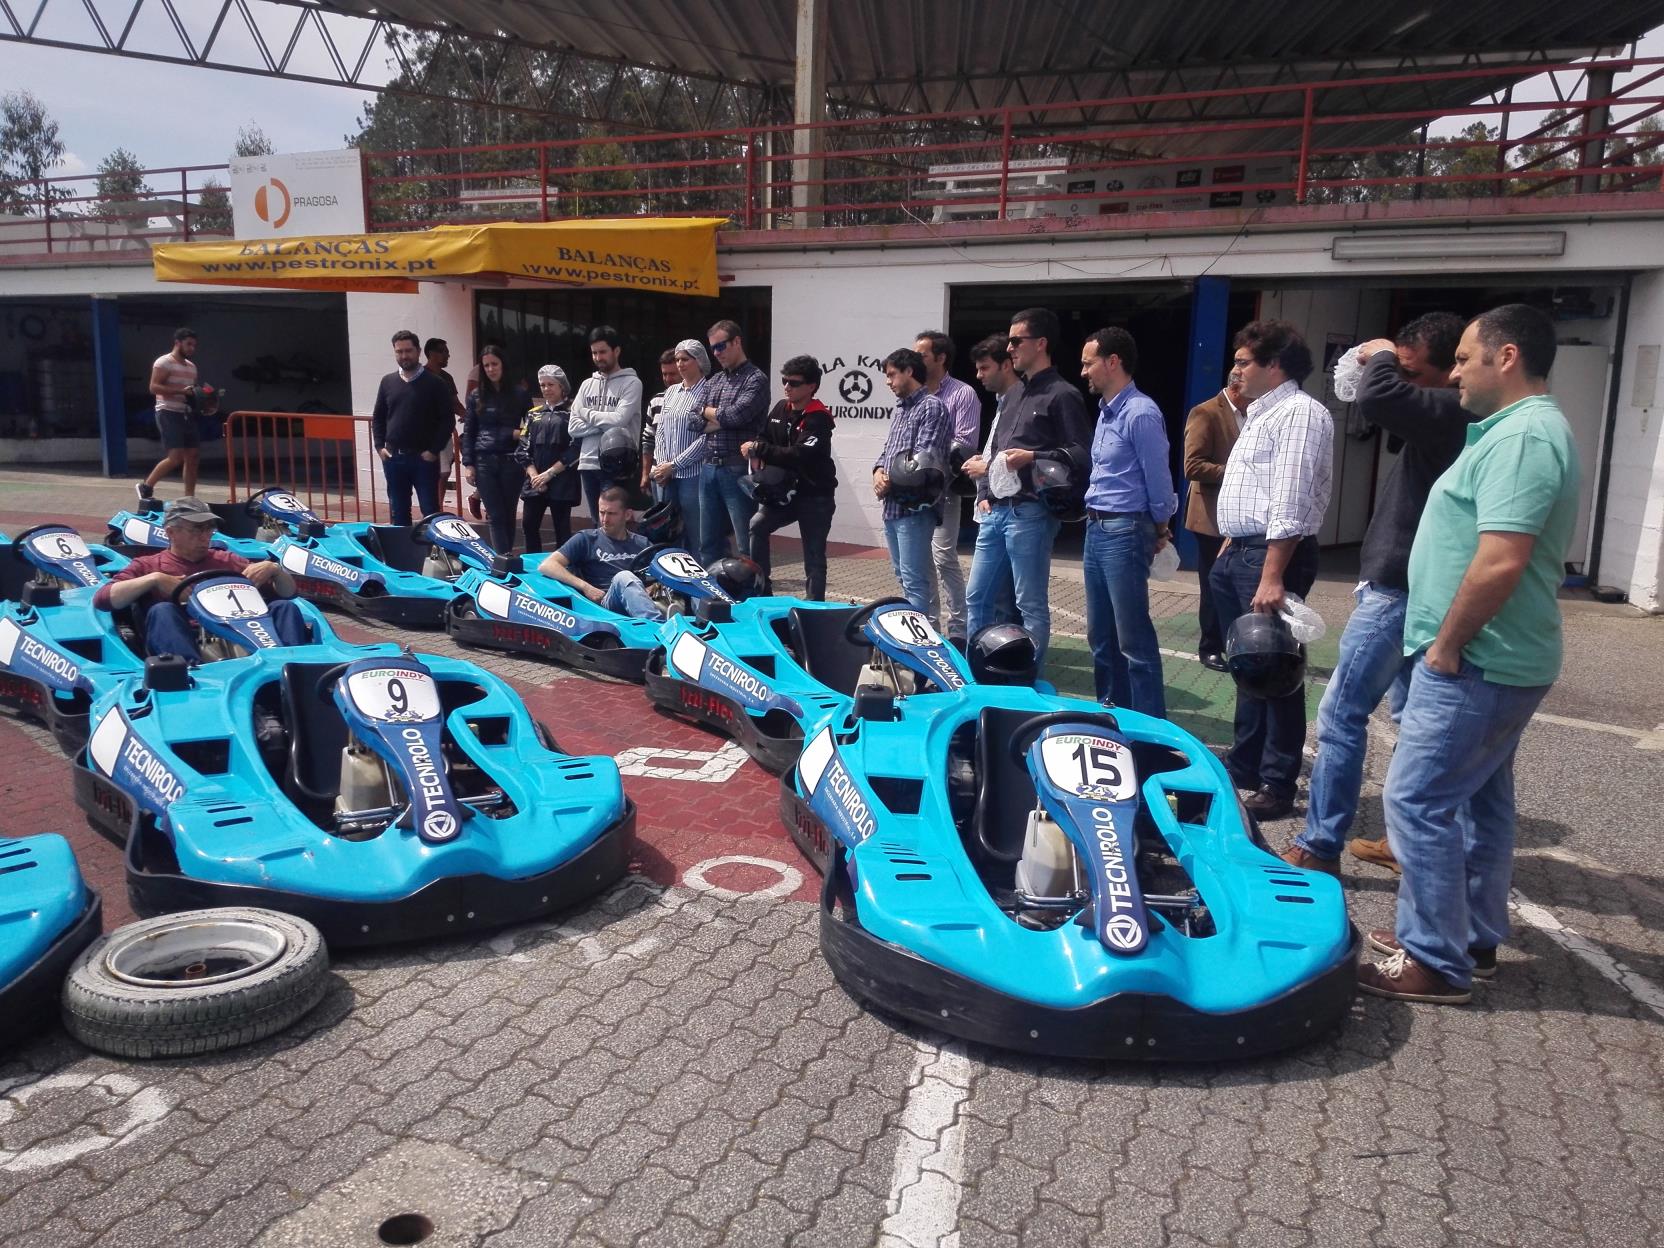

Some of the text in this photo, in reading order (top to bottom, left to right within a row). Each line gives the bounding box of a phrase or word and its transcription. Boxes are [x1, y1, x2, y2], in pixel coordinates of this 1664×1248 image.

[293, 196, 339, 208] PRAGOSA
[239, 239, 390, 258] BALANÇAS
[557, 246, 672, 273] BALANÇAS
[201, 257, 436, 273] www.pestronix.pt
[821, 354, 881, 375] LA KA
[826, 405, 894, 420] UROINDY
[450, 522, 471, 537] 10
[55, 537, 73, 555] 6
[311, 554, 359, 582] TECNIROLO
[671, 556, 704, 574] 25
[206, 584, 253, 594] EUROINDY
[226, 589, 246, 614] 1
[514, 593, 576, 629] TECNIROLO
[900, 615, 929, 640] 16
[20, 635, 78, 682] TECNIROLO
[361, 669, 426, 681] EUROINDY
[707, 652, 768, 701] TECNIROLO
[387, 678, 409, 715] 9
[1055, 735, 1123, 752] EUROINDY
[402, 727, 447, 811] TECNIROLO
[1071, 743, 1123, 788] 15
[826, 758, 875, 841] TECNIROLO
[1091, 806, 1134, 913] TECNIROLO
